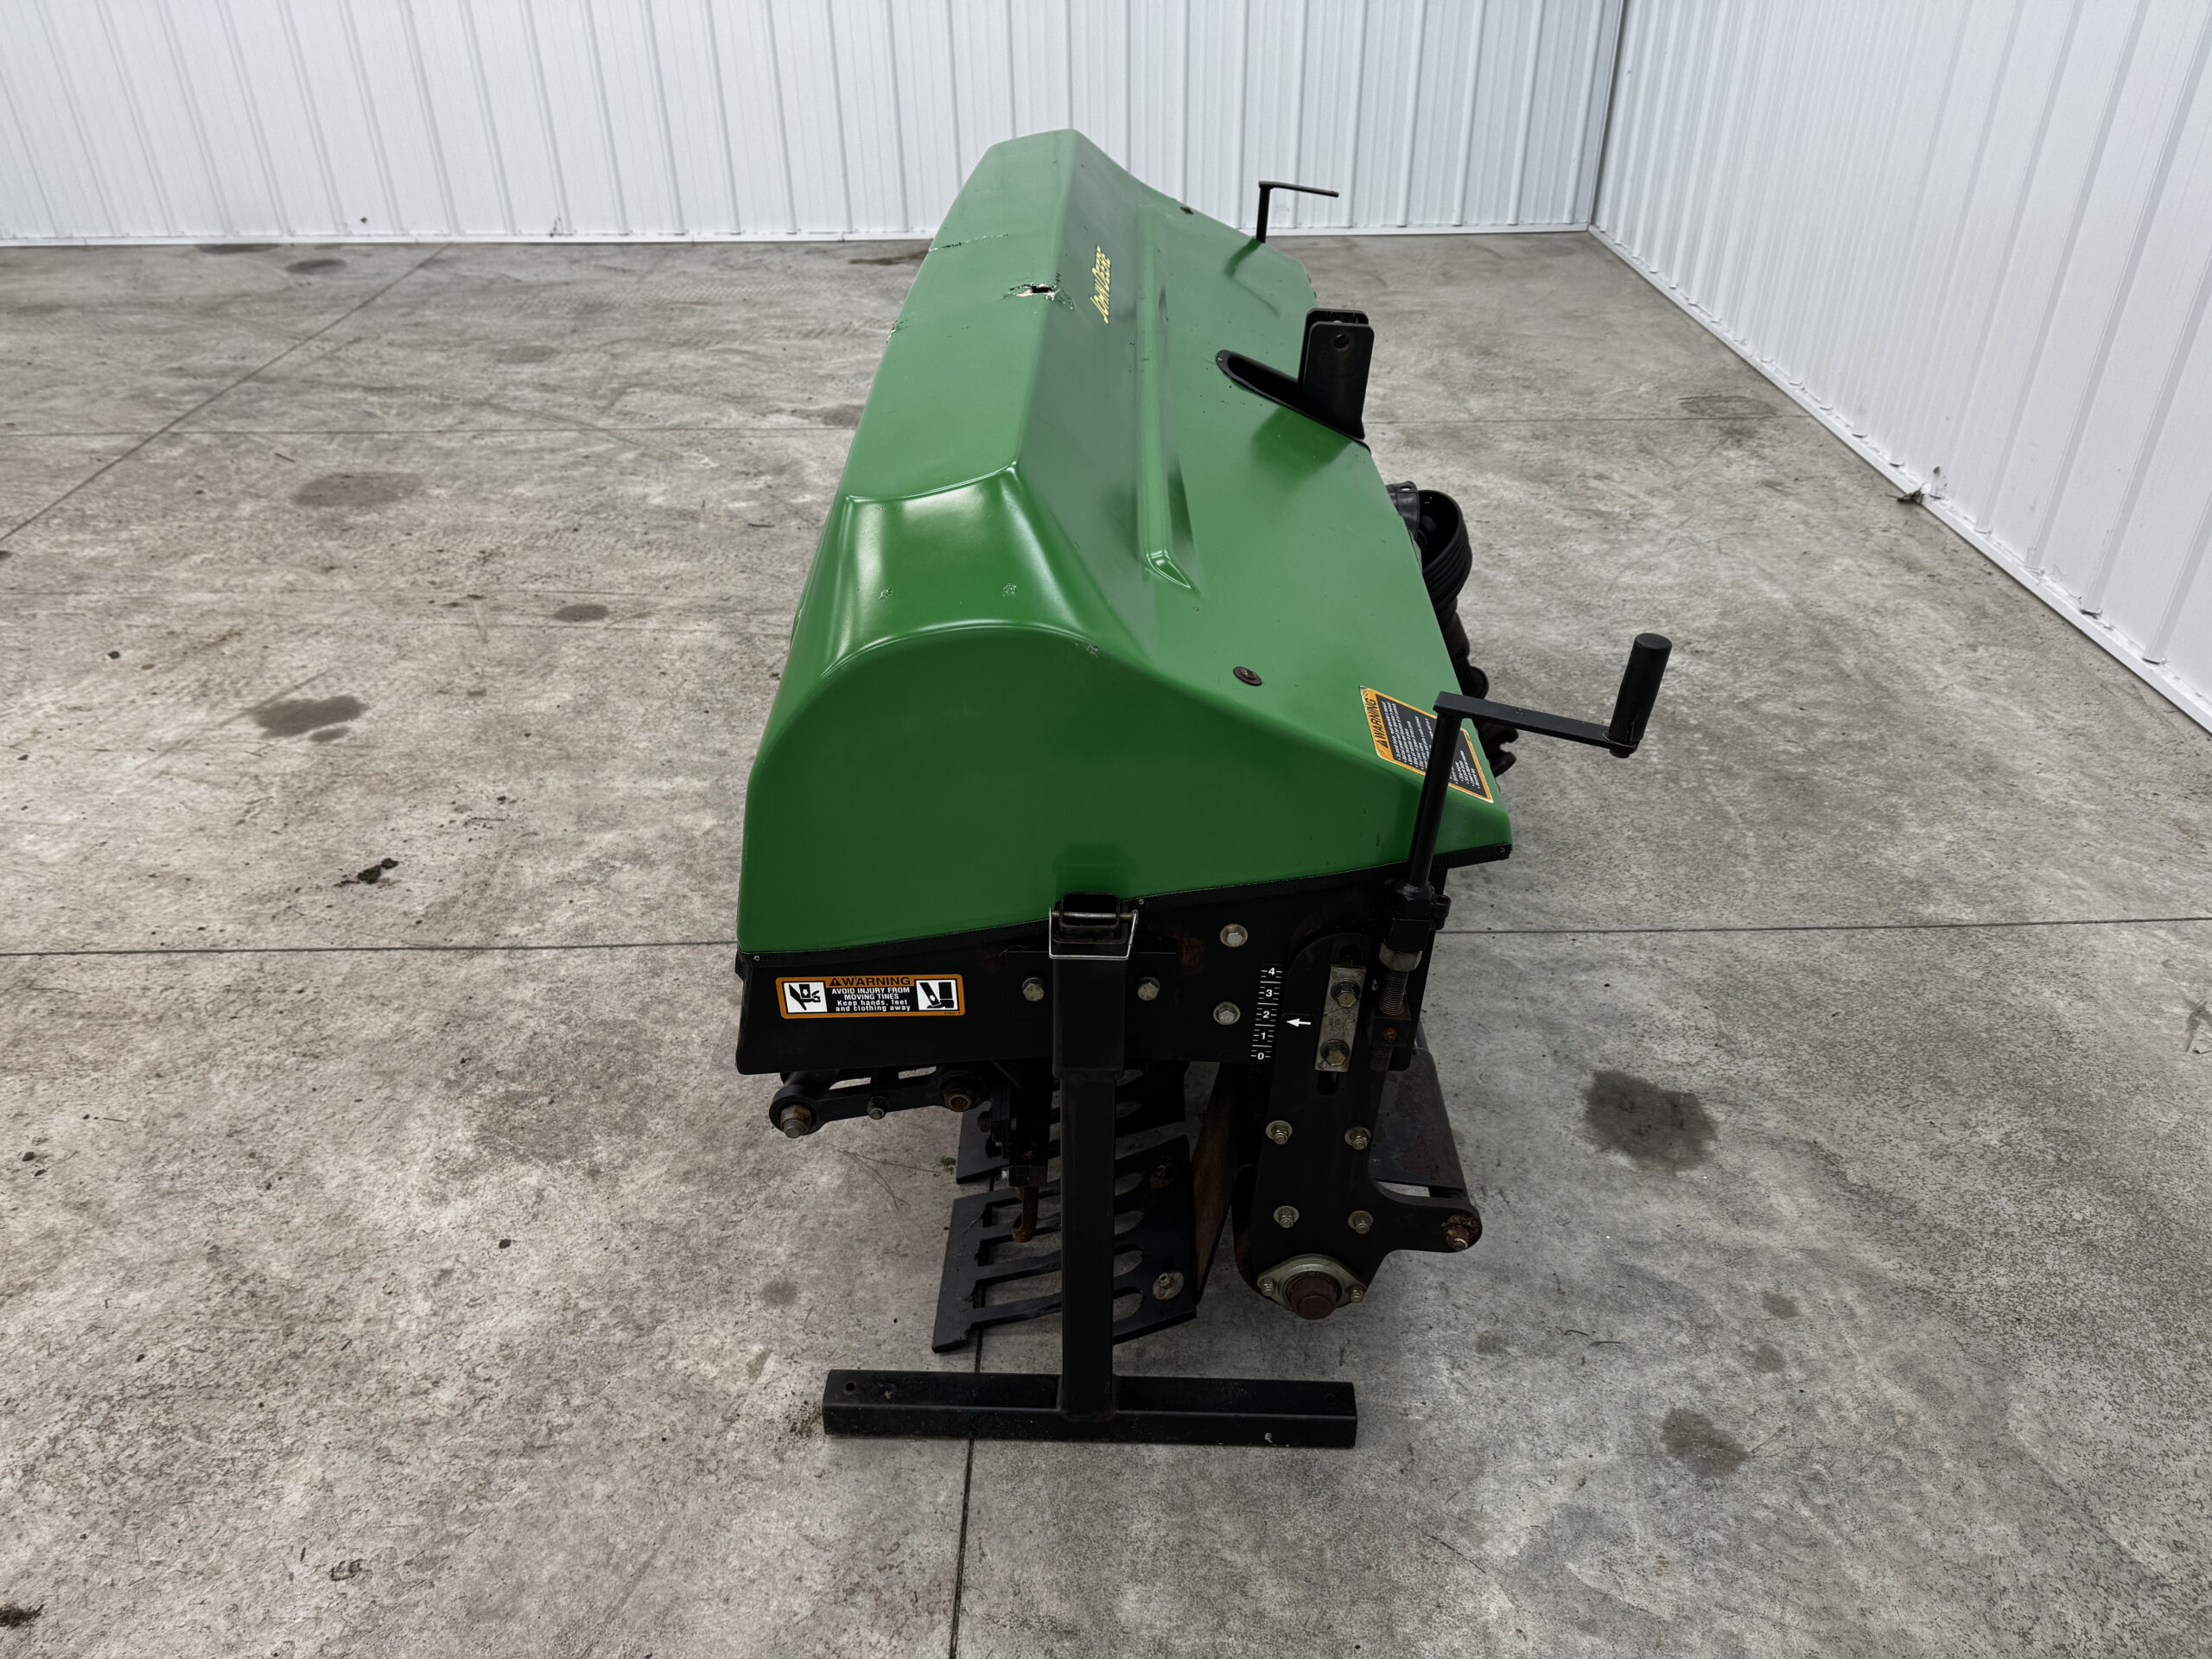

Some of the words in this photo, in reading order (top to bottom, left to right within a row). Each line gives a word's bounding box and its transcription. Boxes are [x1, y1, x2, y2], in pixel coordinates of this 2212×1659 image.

[1092, 245, 1111, 291] DEERE
[1090, 279, 1109, 324] JOHN
[1365, 698, 1387, 743] WARNING
[842, 977, 910, 987] WARNING
